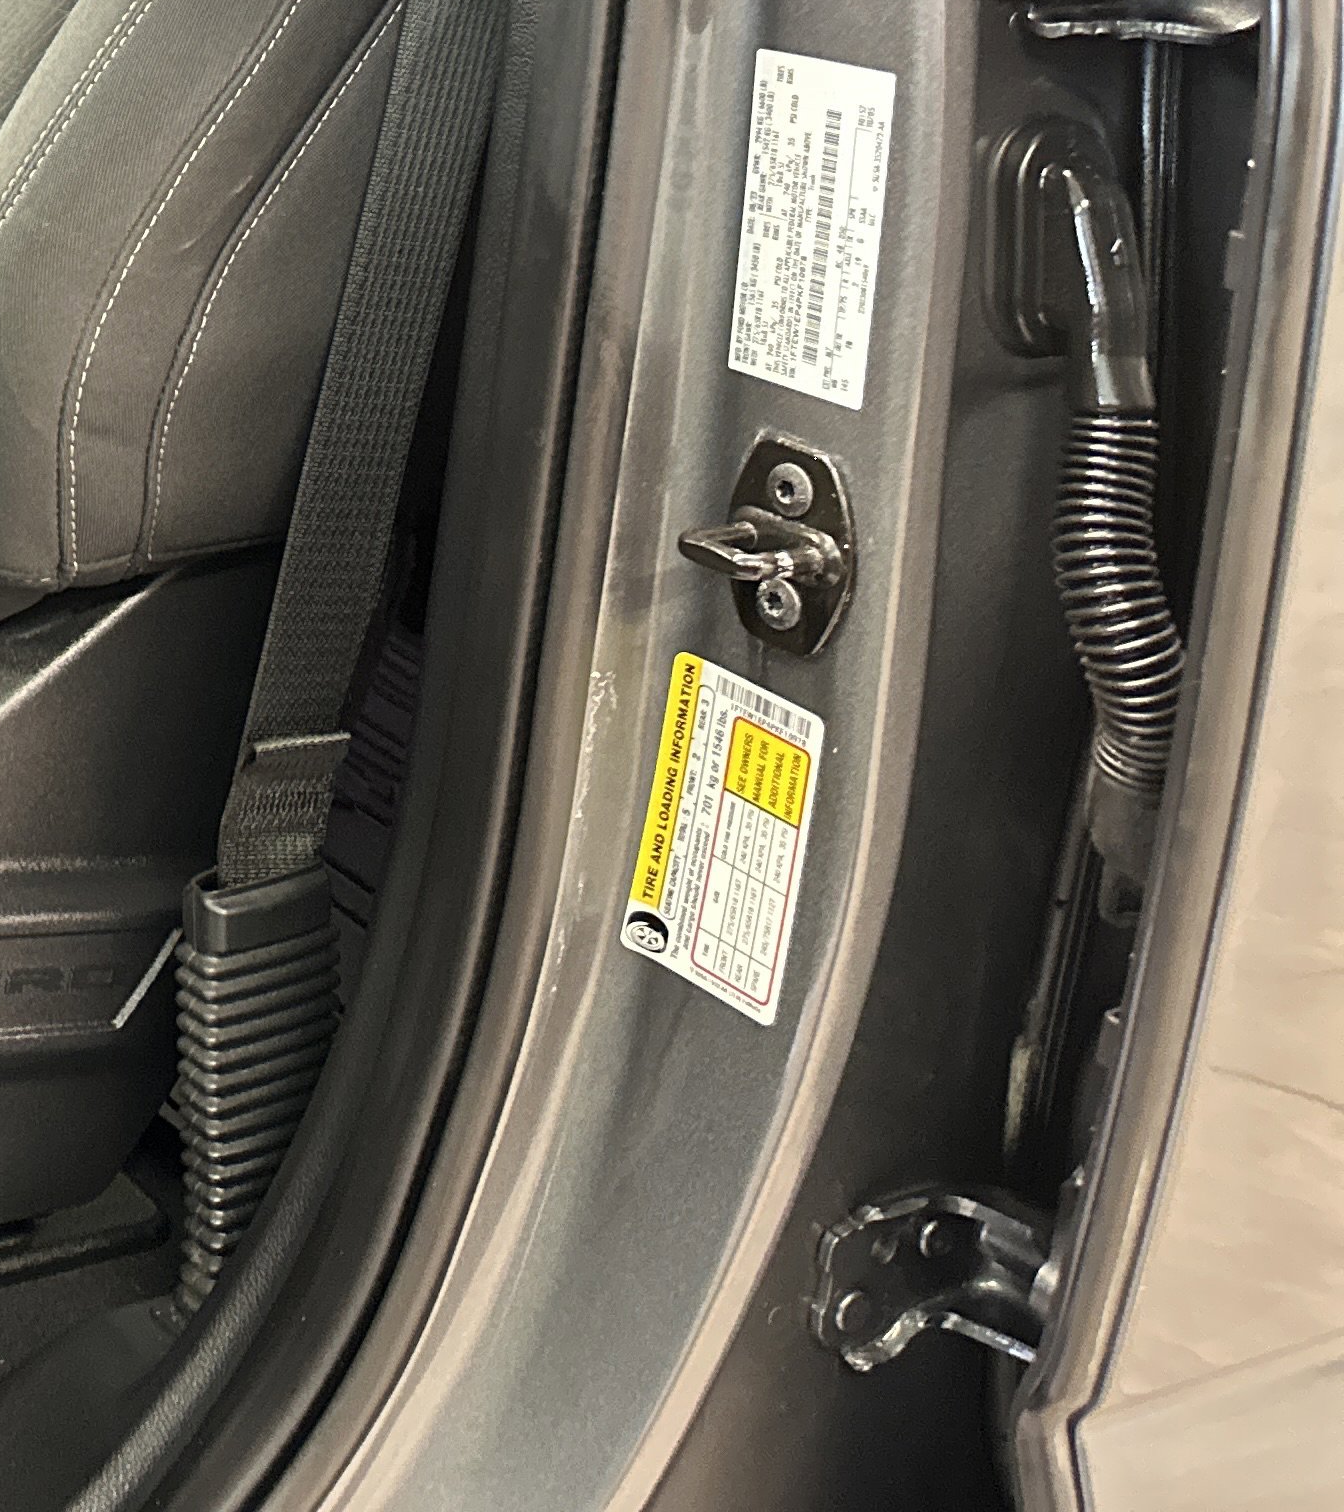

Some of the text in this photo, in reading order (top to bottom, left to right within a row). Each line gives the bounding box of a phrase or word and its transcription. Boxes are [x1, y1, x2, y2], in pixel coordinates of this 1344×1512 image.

[642, 663, 695, 899] TIRE AND LOADING INFORMATION
[706, 774, 720, 790] kg
[710, 759, 720, 773] or
[736, 775, 747, 795] SEE
[752, 740, 770, 803] MANUAL FOR
[768, 752, 785, 809] ADDITIONAL
[700, 794, 714, 816] 701
[784, 753, 801, 820] INFORMATION
